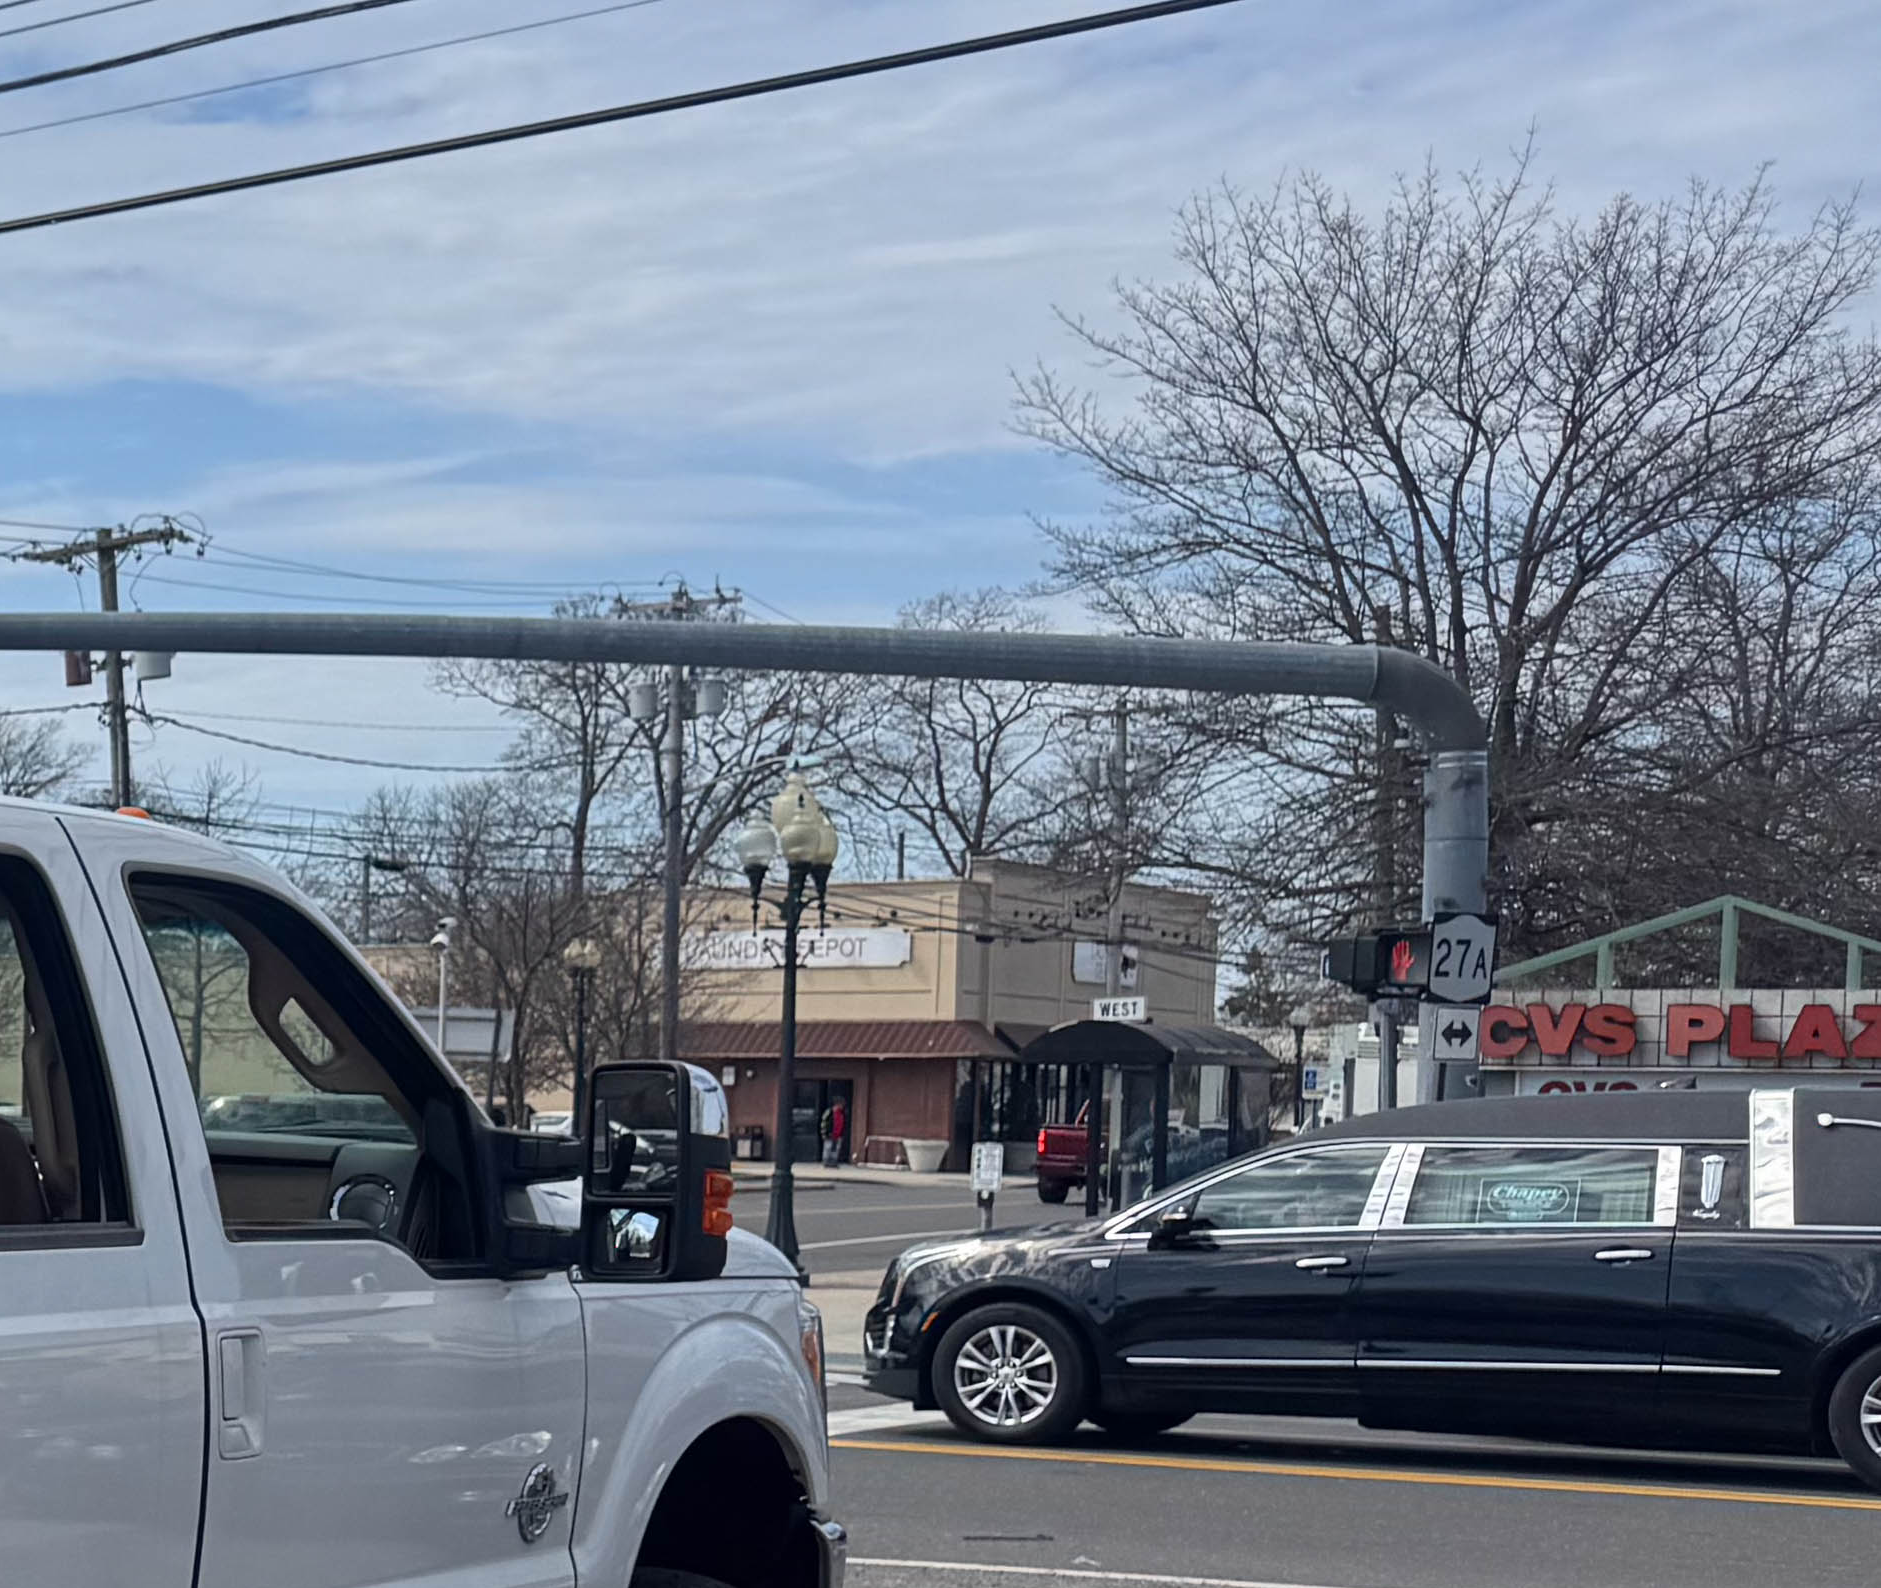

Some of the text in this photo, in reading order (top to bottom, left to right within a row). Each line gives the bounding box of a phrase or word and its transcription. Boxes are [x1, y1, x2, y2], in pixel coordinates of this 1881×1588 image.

[1434, 937, 1487, 979] 27A
[1099, 1002, 1138, 1017] WEST
[1480, 1003, 1636, 1058] CVS
